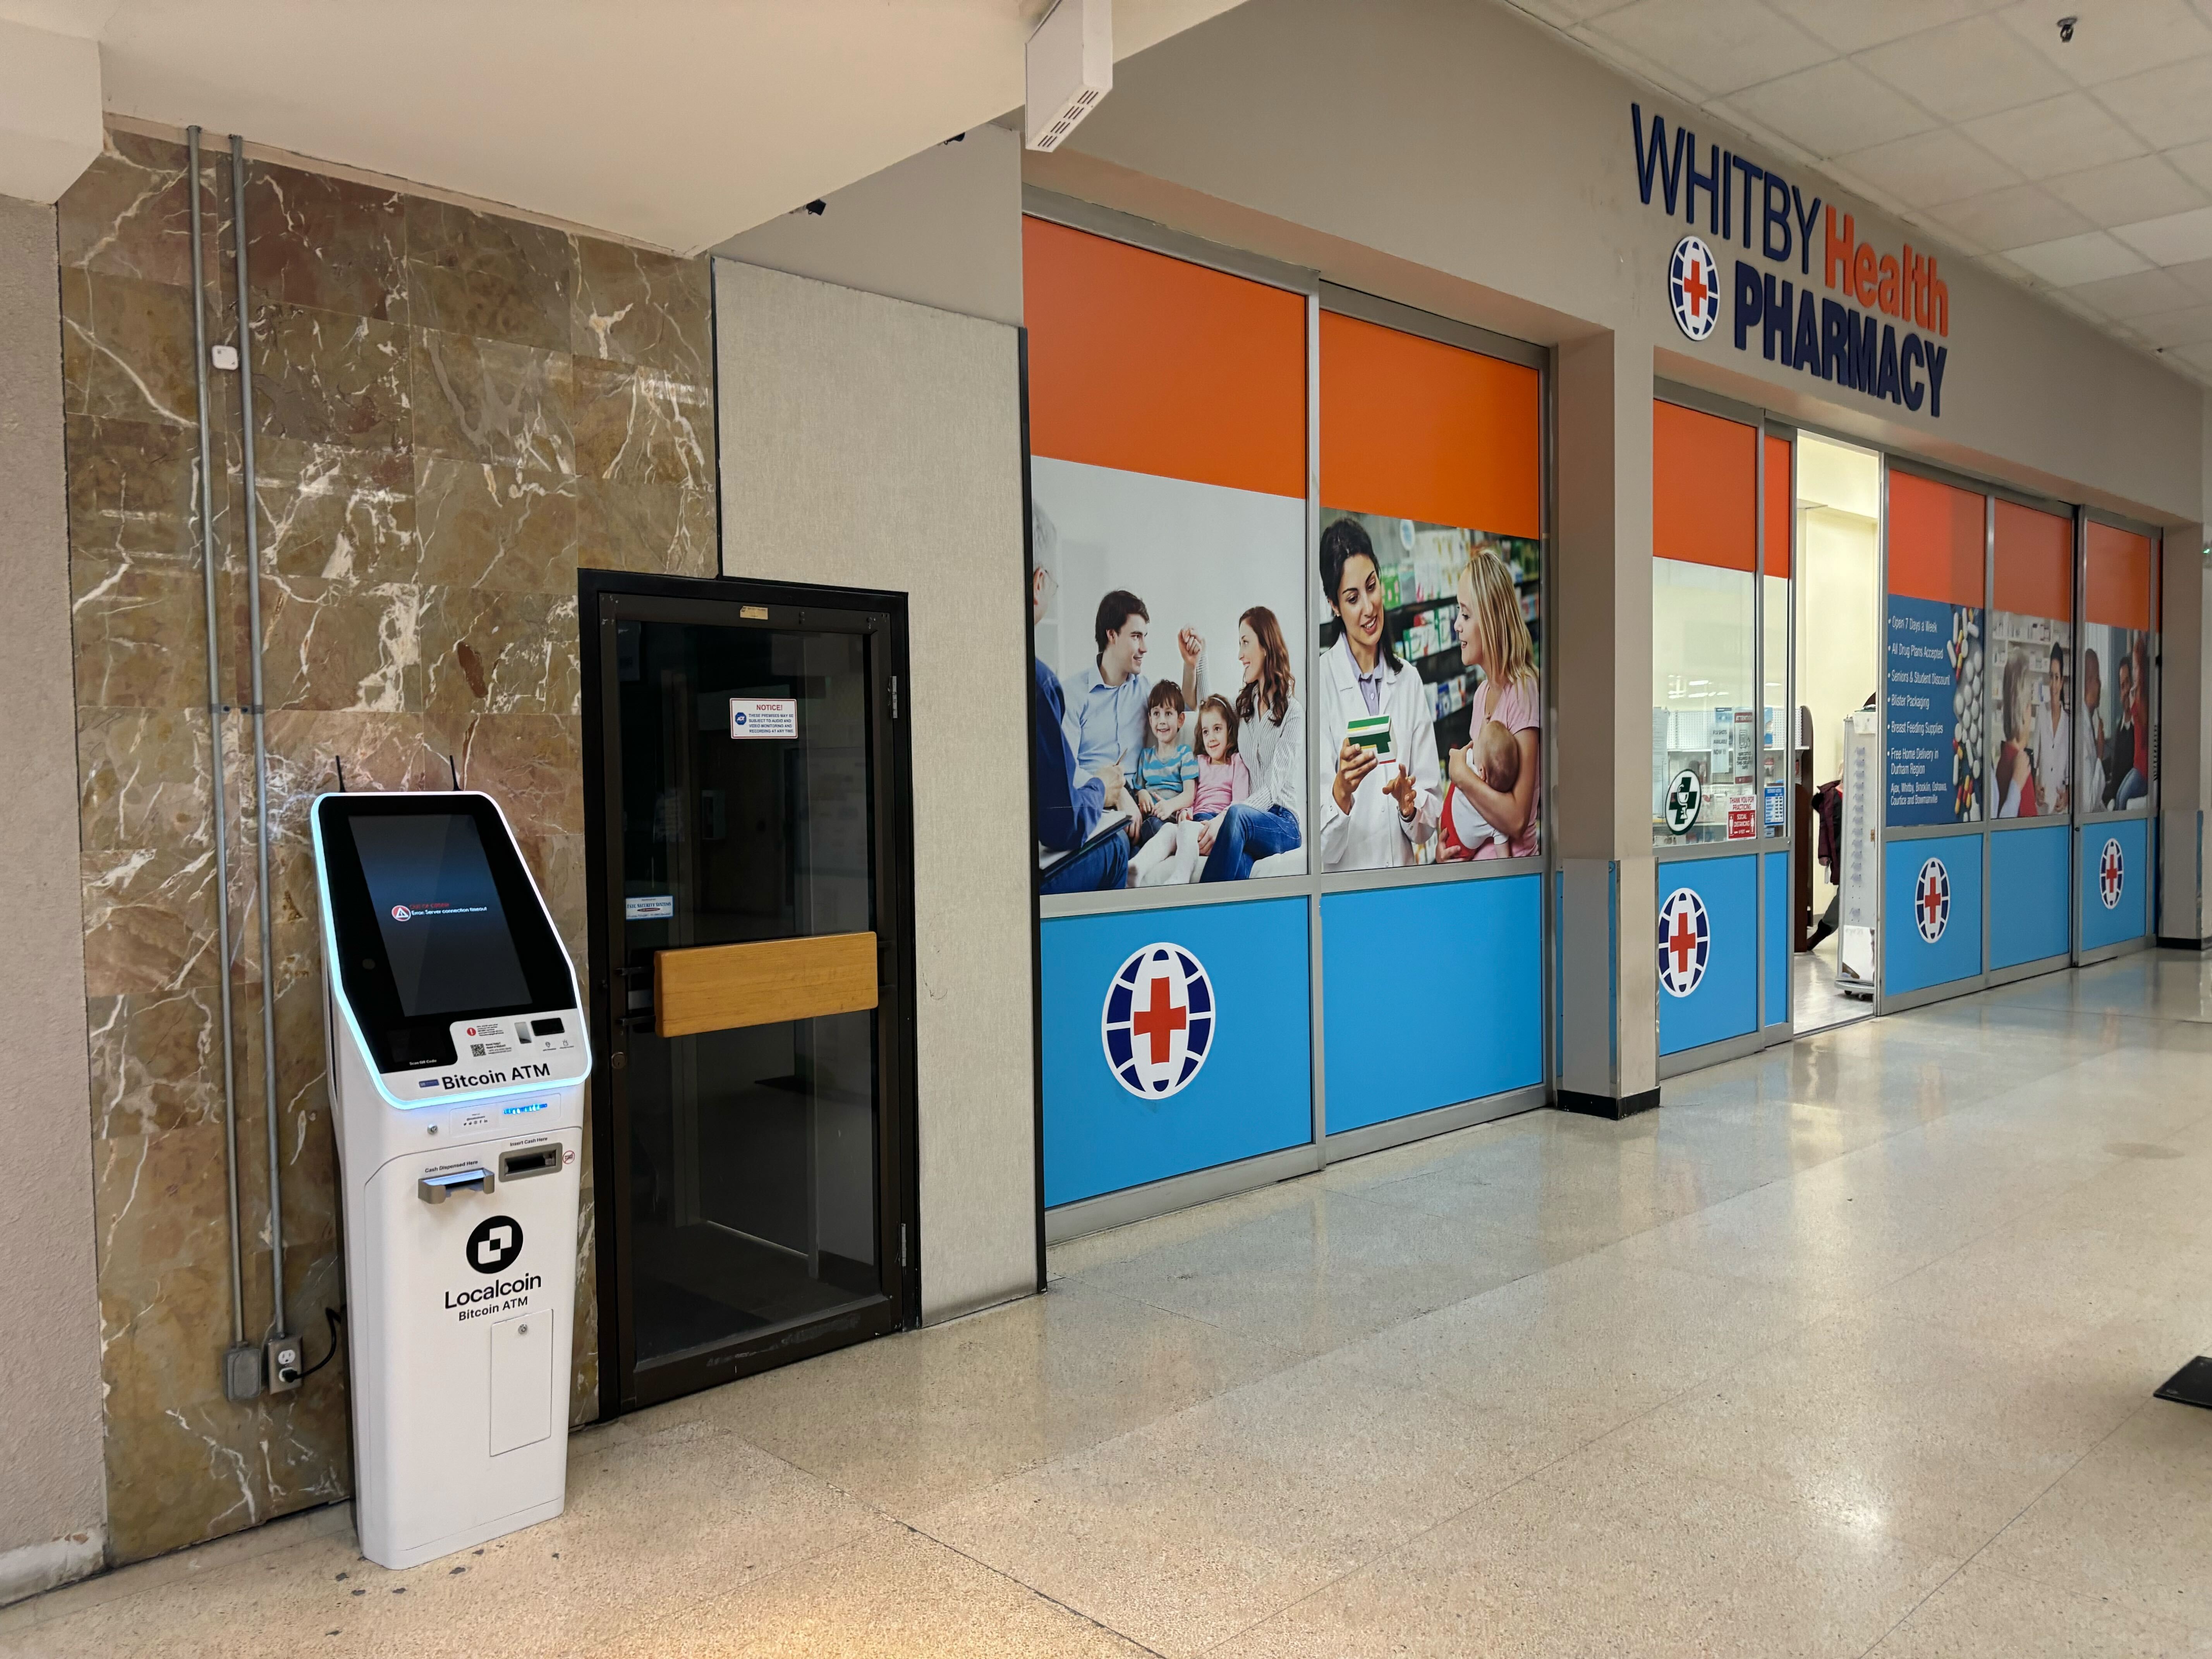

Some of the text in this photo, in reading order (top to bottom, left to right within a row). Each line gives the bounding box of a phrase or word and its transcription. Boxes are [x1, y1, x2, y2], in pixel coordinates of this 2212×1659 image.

[1632, 103, 1948, 337] WHITBY Health
[1734, 260, 1948, 417] PHARMACY
[1892, 615, 1937, 633] Open 7 Days a Week
[1899, 643, 1910, 658] Drug
[1911, 645, 1923, 657] Plans
[1923, 646, 1943, 660] Accepted
[1891, 670, 1950, 685] Seniors & Student Discount
[1891, 694, 1930, 710] Blister Packaging
[1891, 721, 1943, 736] Breast Feeding Supplies
[1891, 747, 1939, 762] Free Home Delivery in
[1891, 763, 1925, 776] Durham Region
[442, 1063, 550, 1090] Bitcoin ATM
[439, 1162, 465, 1171] Dispensed
[445, 1273, 541, 1309] Localcoin
[459, 1296, 528, 1321] Bitcoin ATM
